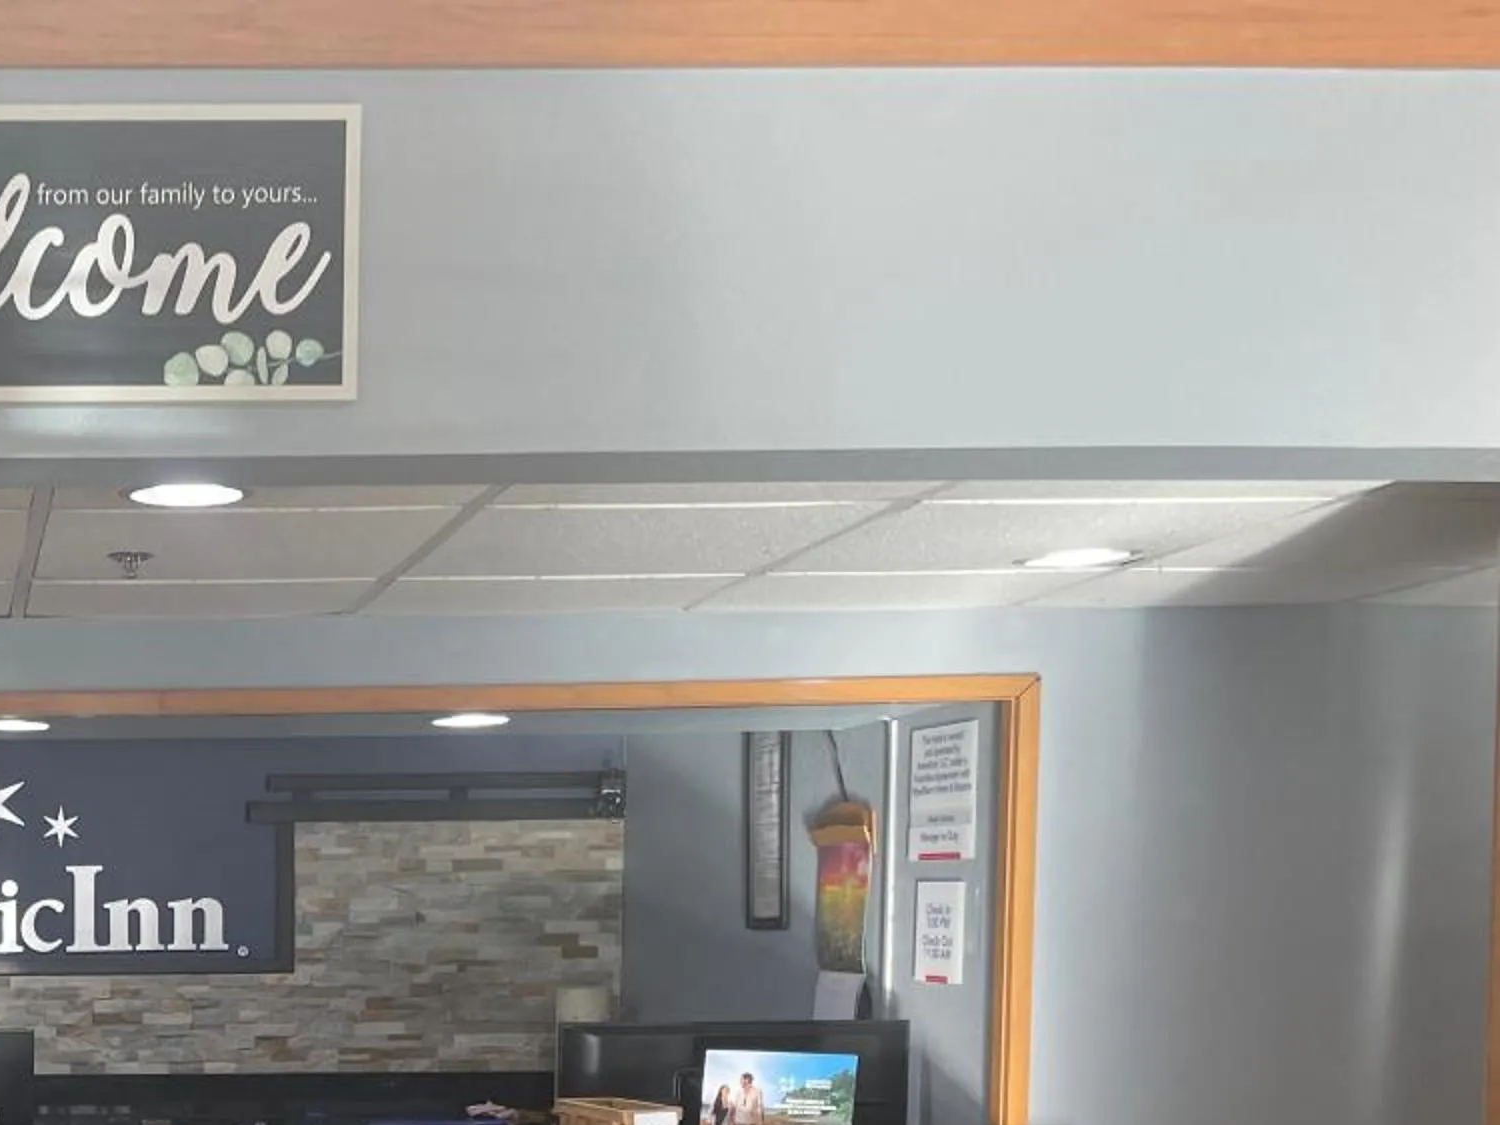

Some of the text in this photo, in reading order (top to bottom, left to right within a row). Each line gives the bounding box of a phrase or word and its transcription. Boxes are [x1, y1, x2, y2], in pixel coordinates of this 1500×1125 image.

[37, 182, 89, 205] from
[96, 186, 134, 205] our
[140, 181, 205, 210] family
[213, 185, 235, 205] to
